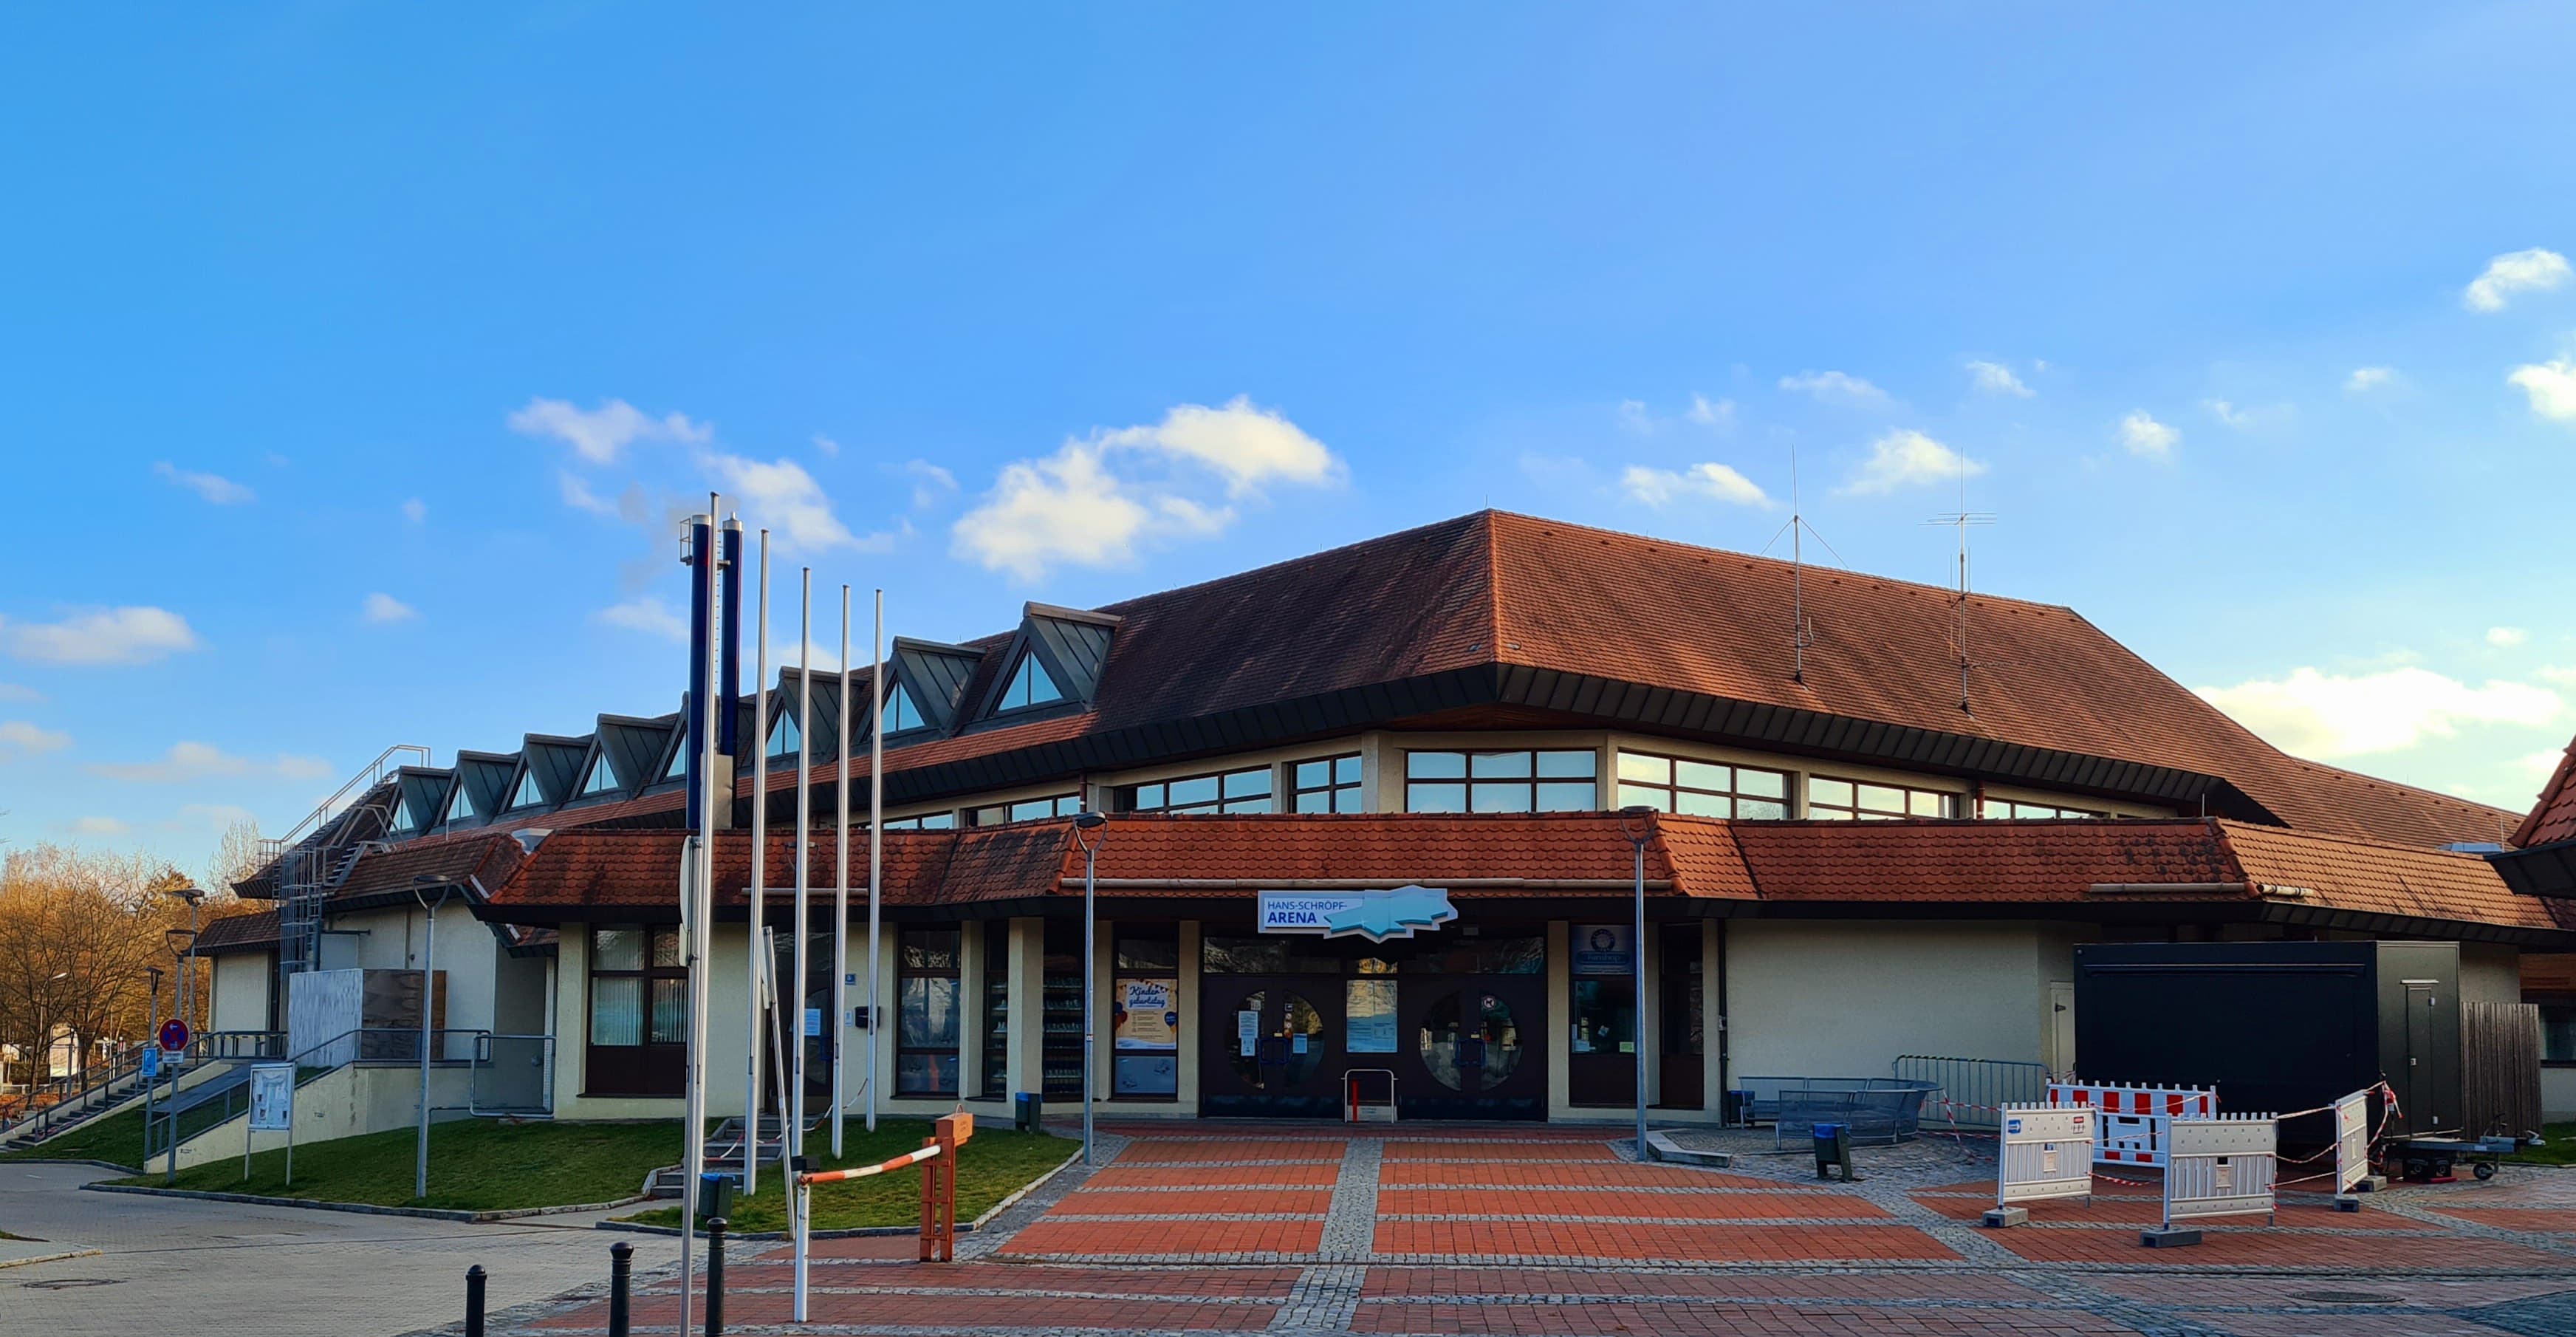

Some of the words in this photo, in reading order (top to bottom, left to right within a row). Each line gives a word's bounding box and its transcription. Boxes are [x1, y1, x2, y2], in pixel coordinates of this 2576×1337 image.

[1267, 912, 1317, 923] ARENA
[1129, 985, 1159, 996] Kinder
[145, 1051, 151, 1061] P
